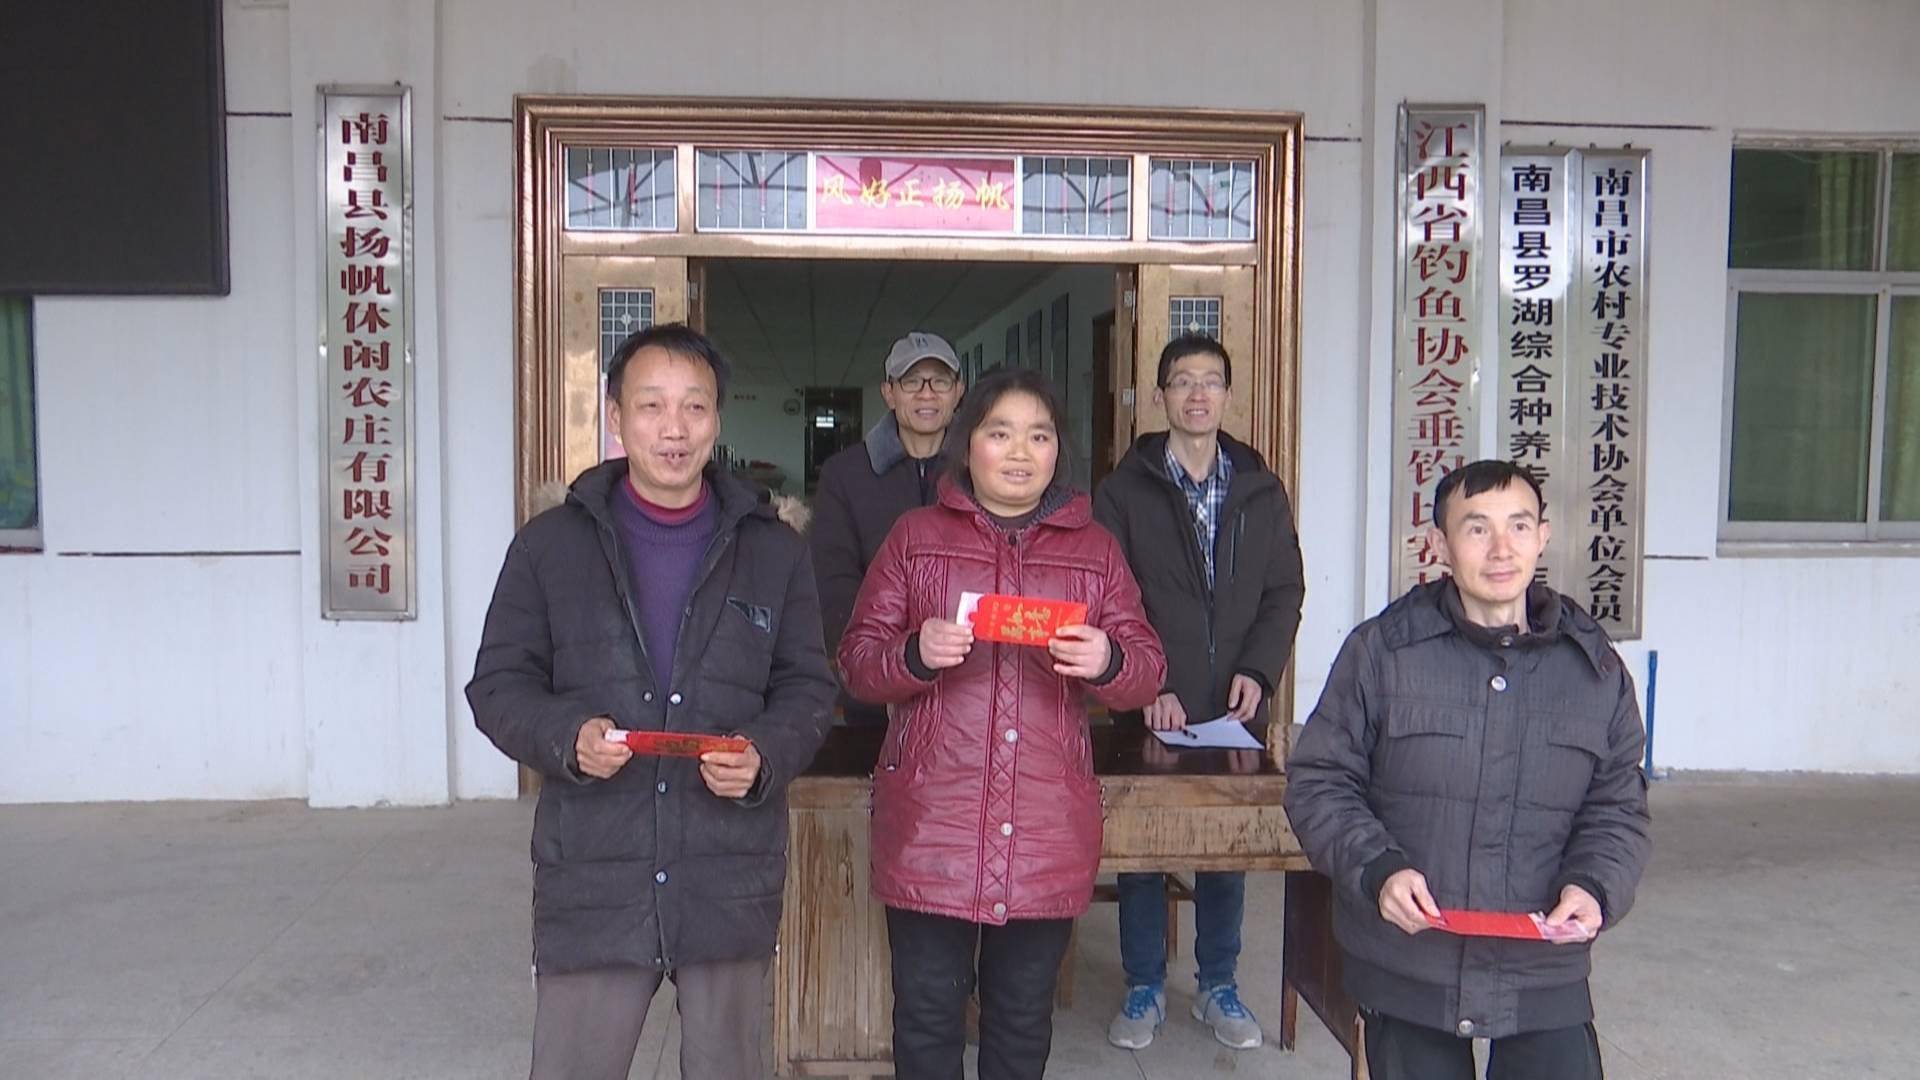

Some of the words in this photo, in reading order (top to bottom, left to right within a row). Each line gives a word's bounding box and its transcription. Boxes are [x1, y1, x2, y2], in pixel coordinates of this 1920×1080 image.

[339, 112, 392, 595] 南昌县扬帆休闲农庄有限公司
[820, 173, 1010, 212] 风好正扬帆
[1407, 120, 1469, 586] 江西省钓鱼协会垂钓
[1510, 164, 1553, 585] 南昌县罗湖综合种养
[1587, 168, 1633, 622] 南昌市农村专业技术协会单位会员
